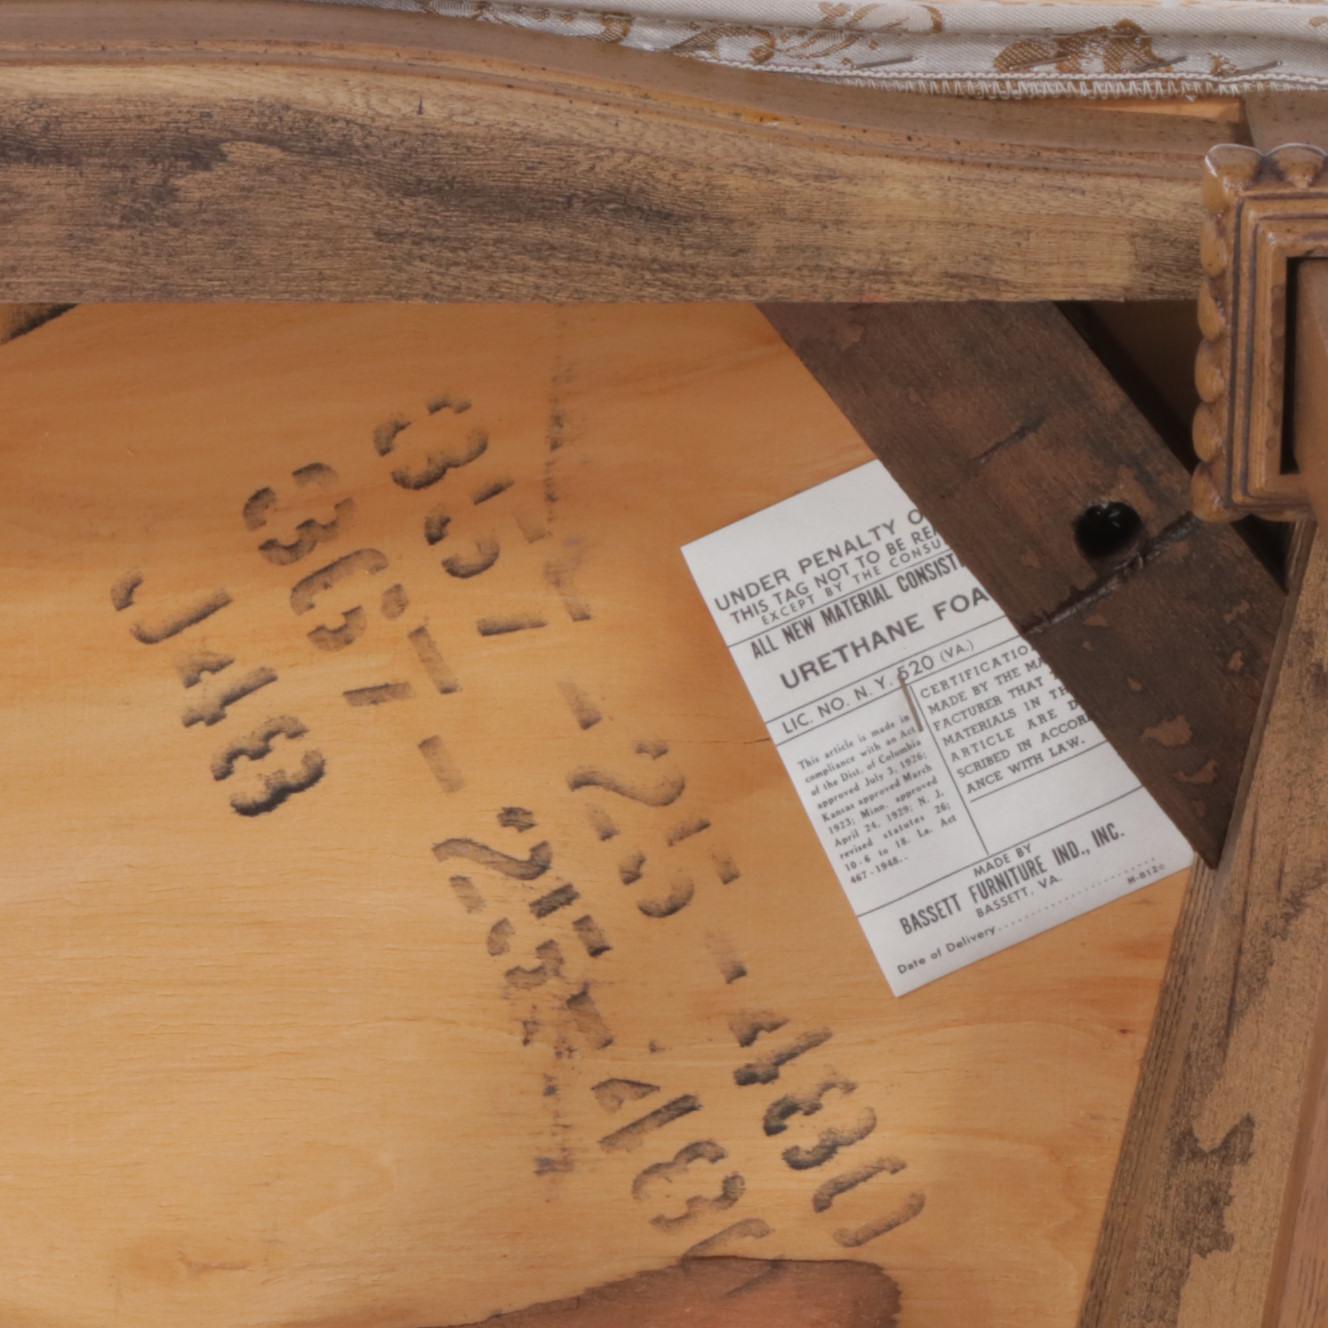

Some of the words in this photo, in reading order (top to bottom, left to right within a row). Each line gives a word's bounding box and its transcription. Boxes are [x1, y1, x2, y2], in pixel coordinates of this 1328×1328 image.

[714, 568, 791, 611] UNDER
[798, 519, 895, 574] PENALTY
[730, 599, 769, 624] THIS
[774, 581, 809, 605] TAG
[814, 562, 849, 588] NOT
[855, 550, 880, 568] TO
[886, 538, 906, 556] BE
[750, 635, 779, 659] ALL
[781, 616, 815, 644] NEW
[820, 584, 893, 626] MATERIAL
[761, 594, 815, 625] EXCEPT
[825, 582, 842, 597] BY
[852, 565, 881, 584] THE
[780, 613, 925, 689] URETHANE
[920, 640, 1037, 698] CERTIFICATIO
[110, 567, 327, 818] J48
[782, 713, 813, 734] LIC.
[817, 697, 850, 718] NO.
[853, 685, 872, 701] N.
[874, 676, 893, 689] Y.
[940, 640, 974, 663] (VA.)
[927, 691, 968, 715] MADE
[971, 681, 988, 696] BY
[994, 667, 1021, 685] THE
[933, 696, 1003, 731] FACTURER
[1008, 676, 1043, 698] THAT
[797, 757, 820, 770] This
[824, 740, 854, 759] article
[857, 735, 867, 743] is
[871, 721, 896, 737] made
[900, 715, 910, 723] in
[942, 708, 1016, 746] MATERIALS
[1024, 697, 1041, 711] IN
[951, 728, 1015, 762] ARTICLE
[1027, 709, 1058, 730] ARE
[957, 749, 1010, 778] SCRIBED
[1017, 739, 1032, 752] IN
[1041, 712, 1092, 743] ACCOR
[805, 756, 855, 783] compliance
[860, 742, 882, 757] with
[886, 737, 897, 746] an
[900, 726, 916, 739] Act
[811, 786, 820, 796] of
[823, 780, 838, 790] the
[867, 759, 876, 770] of
[878, 740, 921, 764] Columbia
[967, 770, 1003, 794] ANCE
[1008, 753, 1044, 774] WITH
[1048, 736, 1085, 757] LAW.
[817, 782, 860, 809] approved
[865, 774, 884, 787] July
[821, 803, 855, 822] Kansas
[858, 778, 902, 805] approved
[902, 765, 932, 783] March
[895, 776, 938, 803] approved
[373, 398, 928, 1249] 357-25-480
[835, 829, 860, 847] April
[840, 838, 874, 860] revised
[883, 815, 925, 839] statutes
[878, 848, 888, 856] to
[940, 814, 957, 827] Act
[899, 893, 961, 935] BASSETT
[968, 855, 1047, 904] FURNITURE
[1052, 841, 1090, 866] IND.,
[1091, 822, 1125, 848] INC.
[973, 854, 1011, 877] MADE
[1015, 843, 1031, 858] BY
[976, 887, 1034, 918] BASSETT,
[1037, 875, 1062, 889] VA.
[897, 958, 926, 974] Date
[930, 948, 942, 960] of
[945, 926, 995, 952] Delivery
